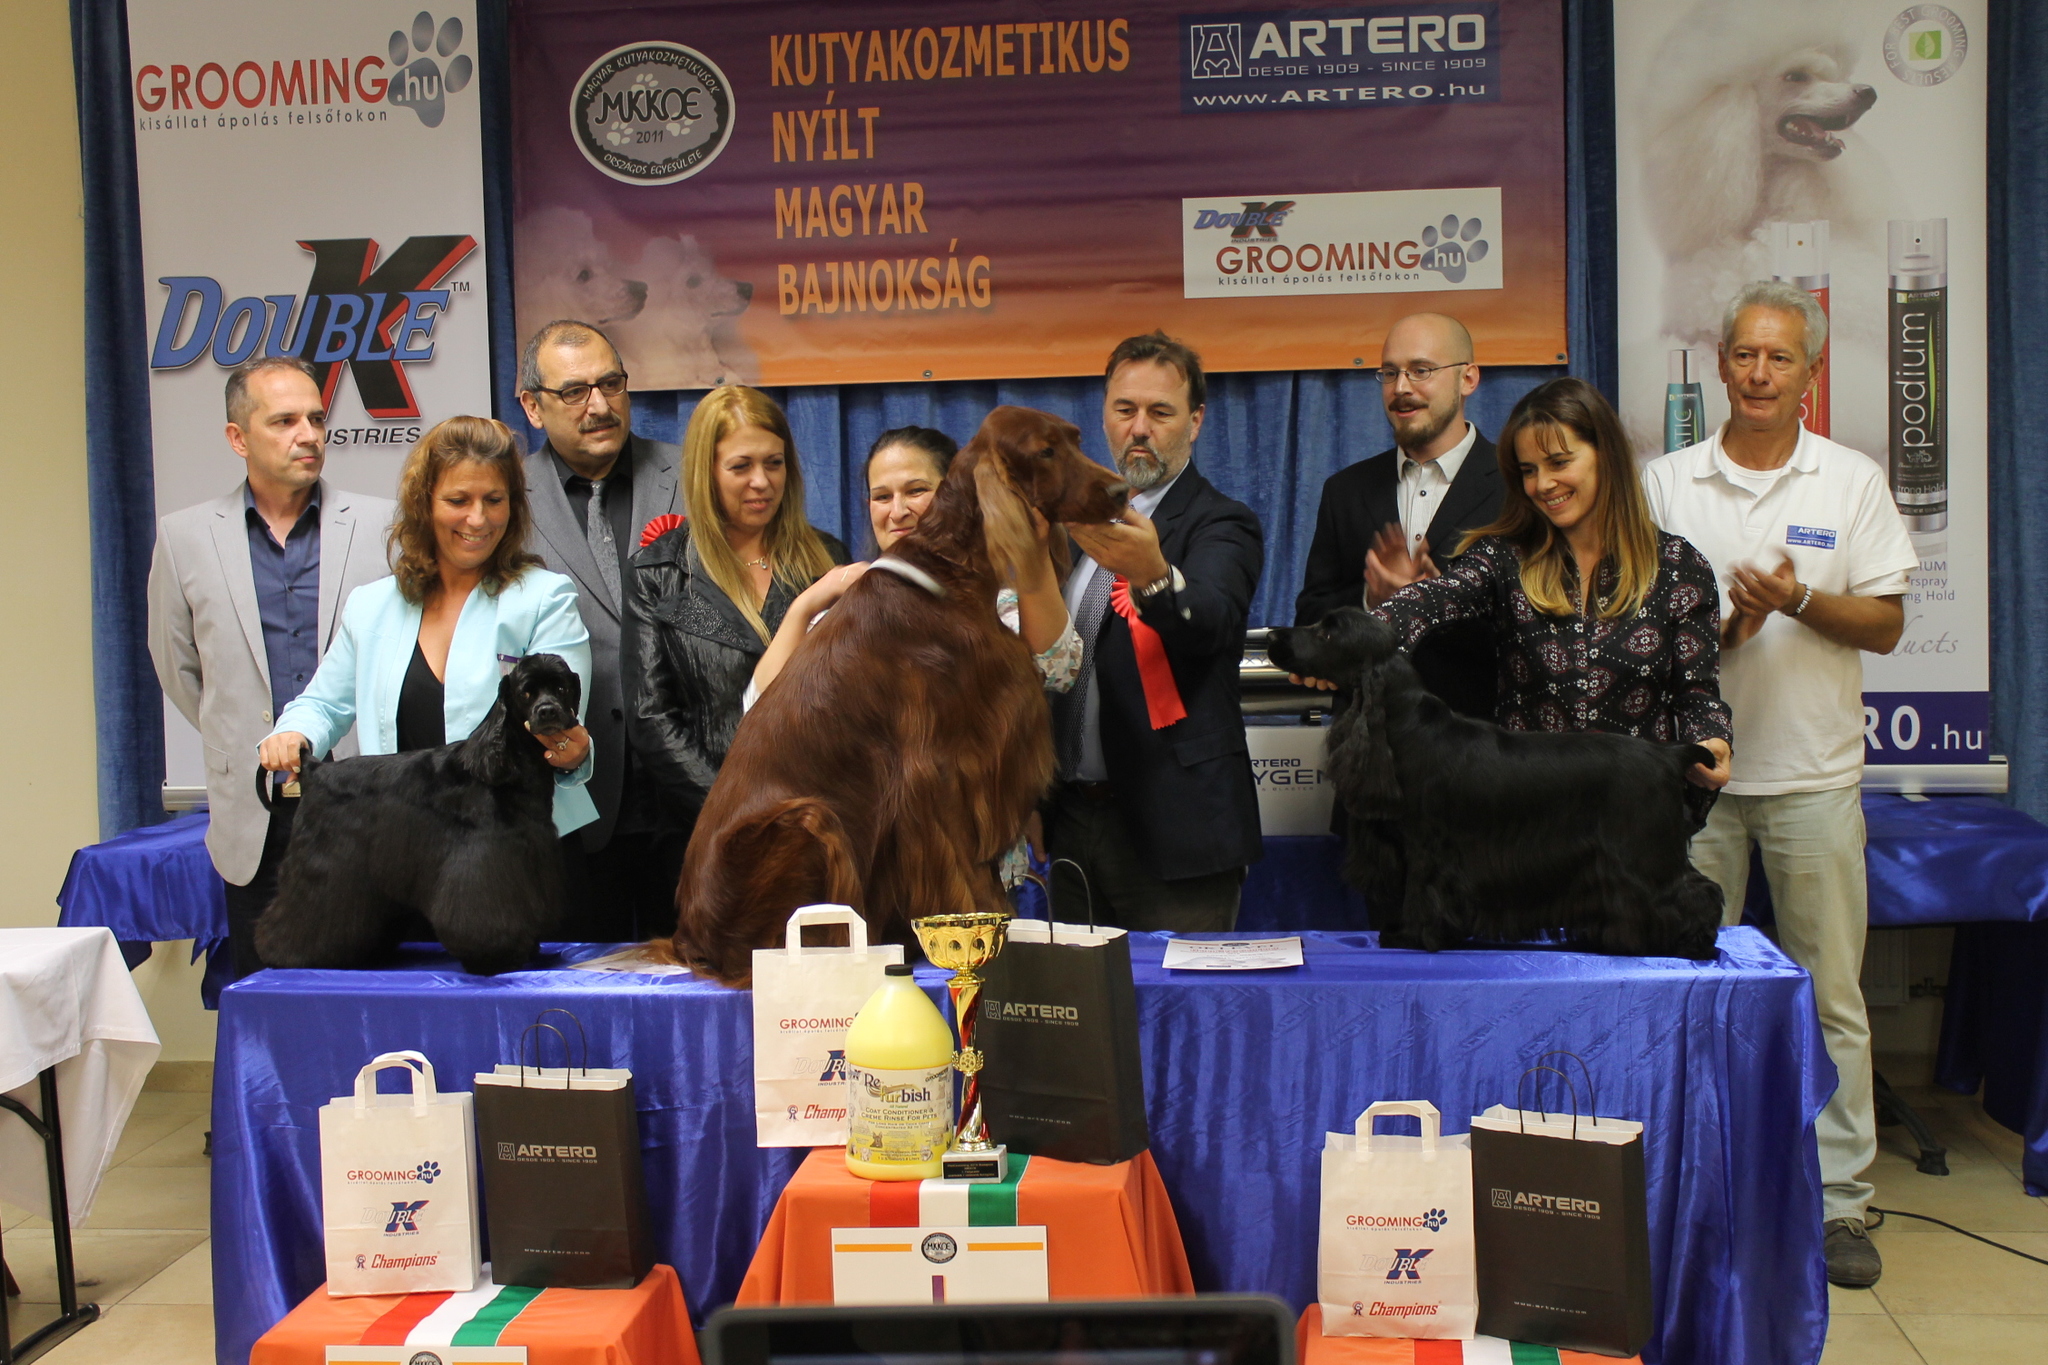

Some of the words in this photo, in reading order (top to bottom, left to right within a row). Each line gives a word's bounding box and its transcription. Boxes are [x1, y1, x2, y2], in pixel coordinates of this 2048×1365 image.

[1249, 14, 1485, 59] ARTERO
[769, 18, 1130, 87] KUTYAKOZMETIKUS
[583, 65, 615, 99] MAGYAR
[616, 50, 721, 94] KUTYAKOZMETIKUSOK
[1249, 65, 1309, 77] DESDE
[1317, 63, 1359, 75] 1909
[1382, 60, 1436, 72] SINCE
[1444, 58, 1486, 70] 1909
[1193, 83, 1485, 106] www.ARTERO.hu
[139, 114, 208, 131] kisállat
[217, 112, 279, 130] ápolás
[288, 108, 388, 125] felsőfokon
[772, 91, 880, 163] NYÍLT
[636, 130, 664, 144] 2011
[603, 153, 647, 174] ORSZÁGOS
[650, 149, 703, 175] EGYESÜLETE
[774, 182, 929, 240] MAGYAR
[777, 238, 992, 315] BAJNOKSÁG
[1218, 275, 1275, 285] kisállat
[1283, 273, 1332, 285] ápolás
[1340, 271, 1420, 282] felsőfokon
[1894, 312, 1934, 449] podium
[1674, 408, 1691, 449] ATIC
[1897, 485, 1922, 495] trong
[1798, 527, 1836, 538] ARTERO
[1920, 561, 1947, 571] IUM
[1911, 578, 1948, 589] rspray
[1926, 589, 1955, 601] Hold
[1251, 758, 1301, 768] RTERO
[1002, 1002, 1078, 1020] ARTERO
[804, 1104, 847, 1121] Champ
[517, 1144, 597, 1158] ARTERO
[1514, 1192, 1600, 1214] ARTERO
[371, 1252, 438, 1270] Champions
[1369, 1301, 1438, 1319] Champions
